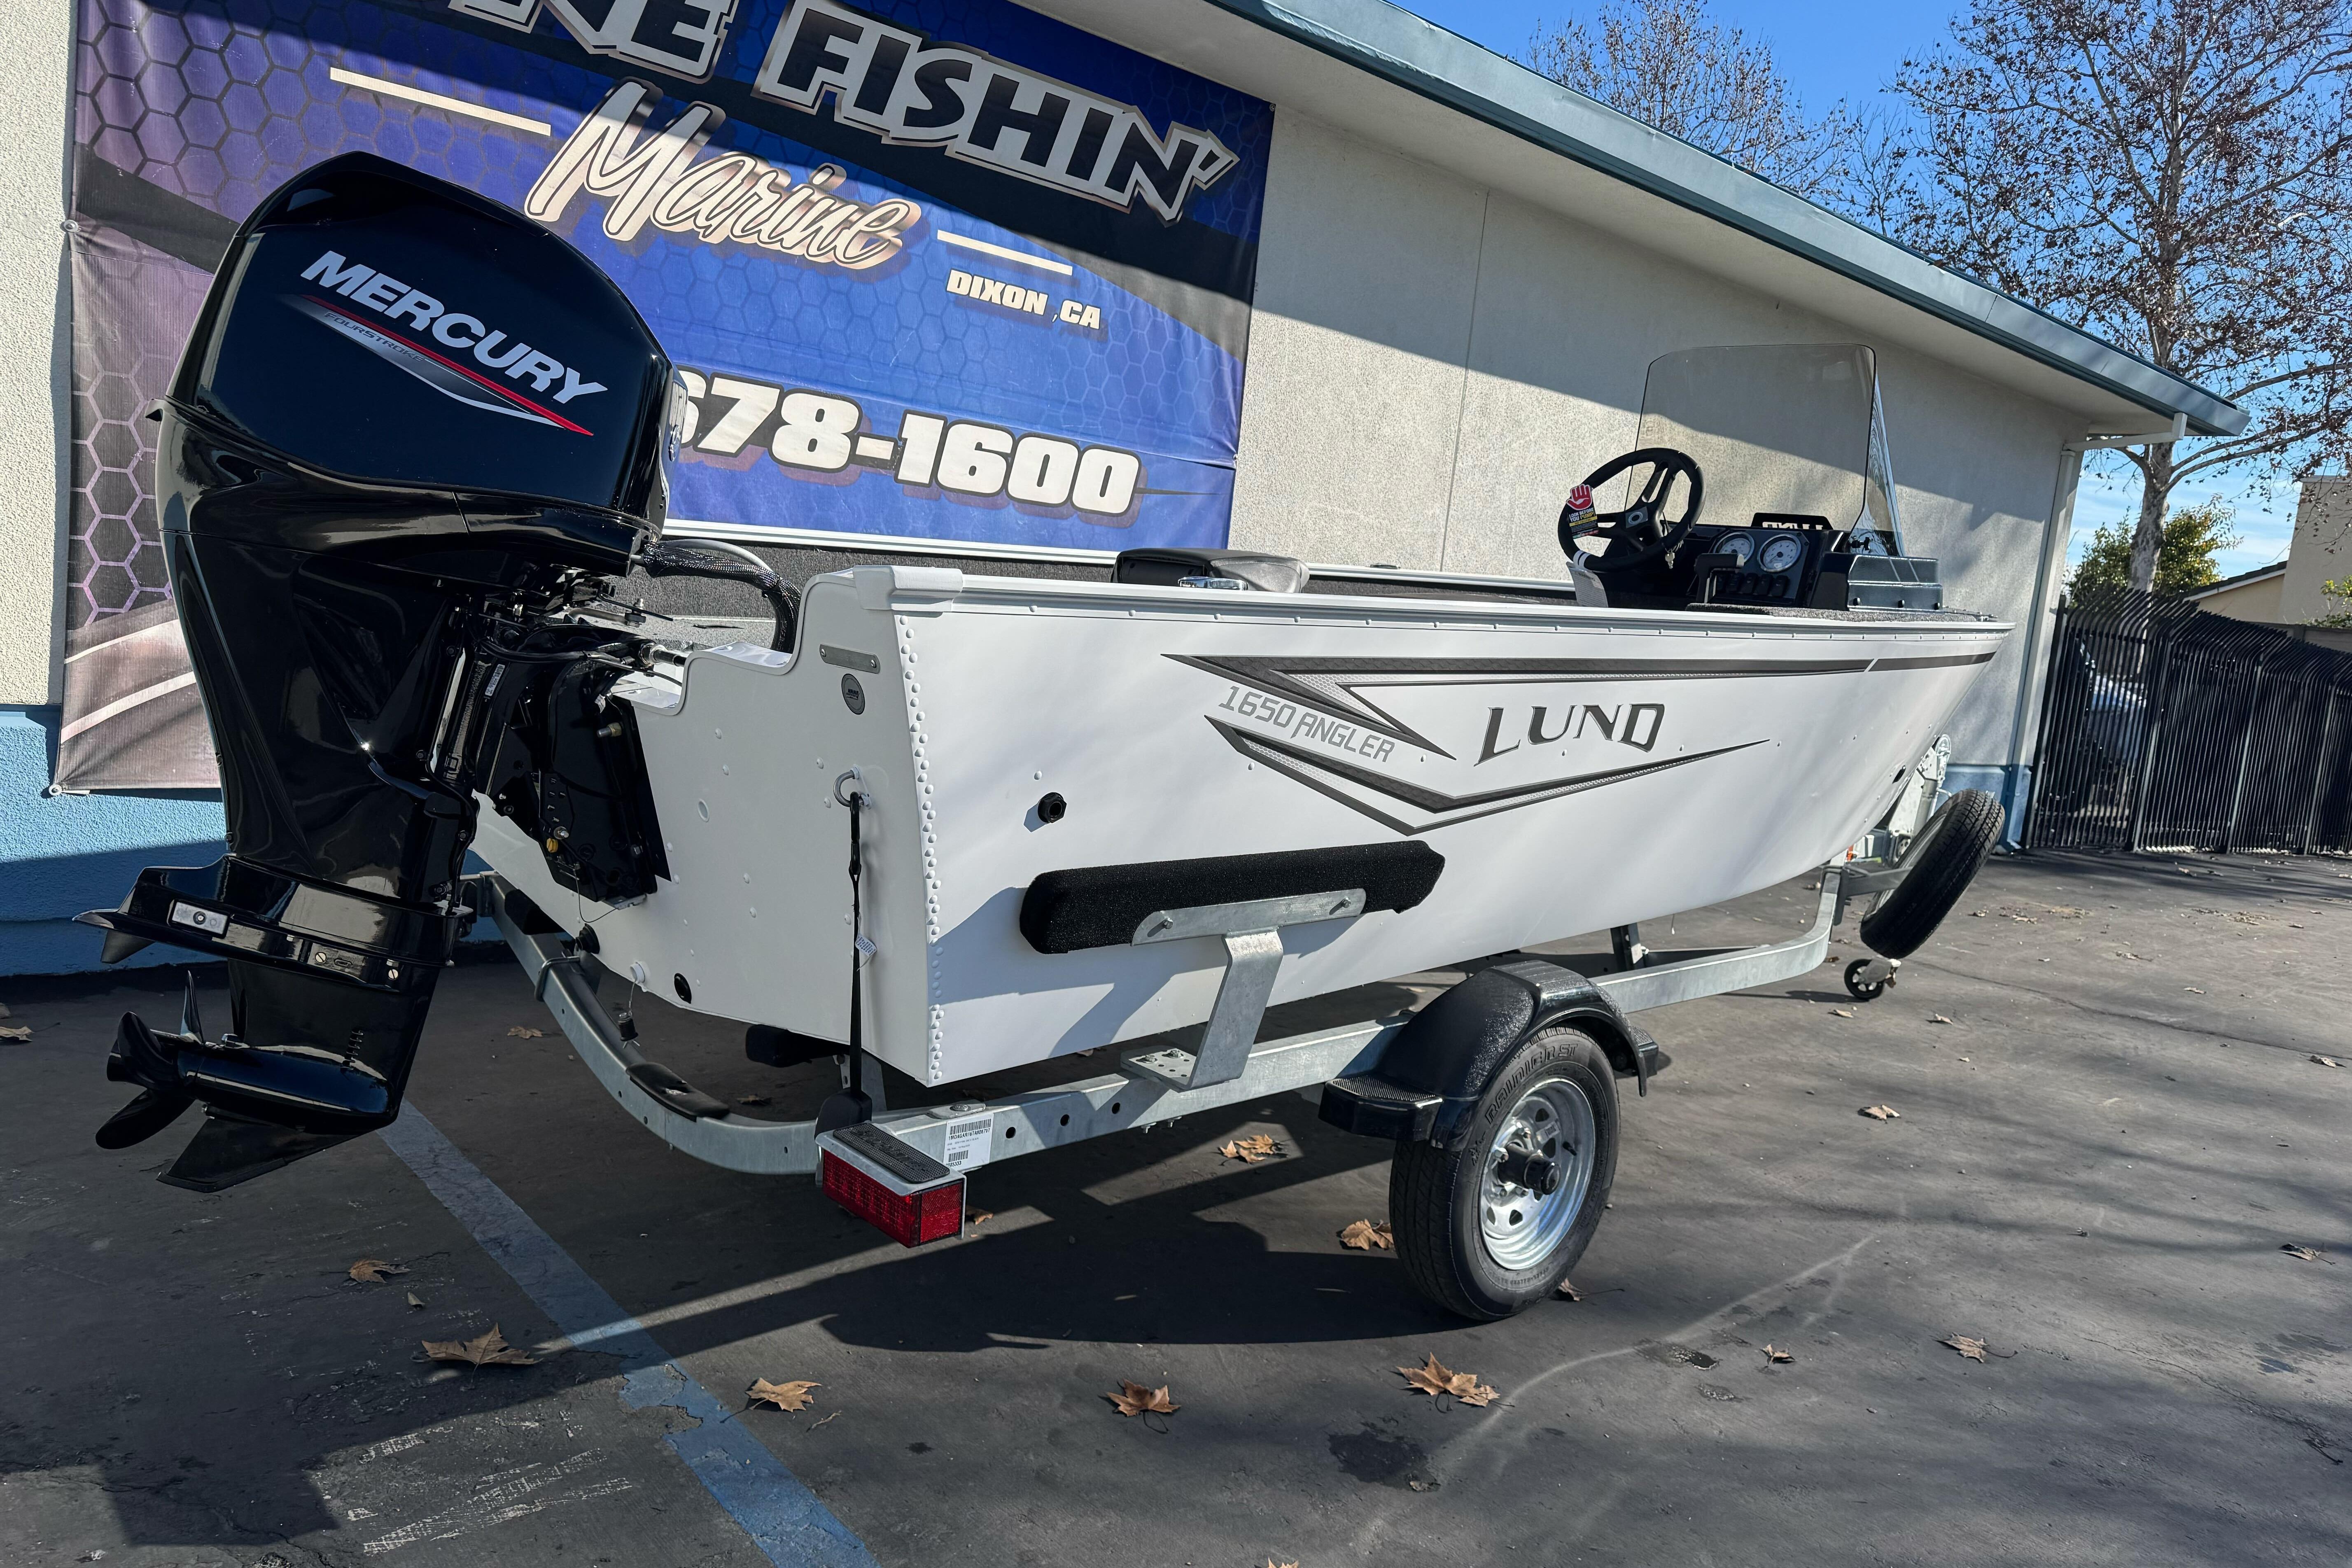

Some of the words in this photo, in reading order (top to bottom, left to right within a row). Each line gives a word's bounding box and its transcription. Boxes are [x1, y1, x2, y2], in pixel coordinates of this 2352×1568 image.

[761, 2, 1234, 220] FISHIN'
[526, 79, 915, 267] Marine
[300, 250, 608, 404] MERCURY
[946, 269, 1049, 316] DIXON
[324, 310, 426, 362] FOURSTROKE
[1218, 686, 1296, 728] 1650
[1290, 712, 1395, 763] ANGLER
[1473, 703, 1665, 767] LUND
[1484, 1046, 1556, 1125] RAINIER
[1559, 1043, 1579, 1057] ST
